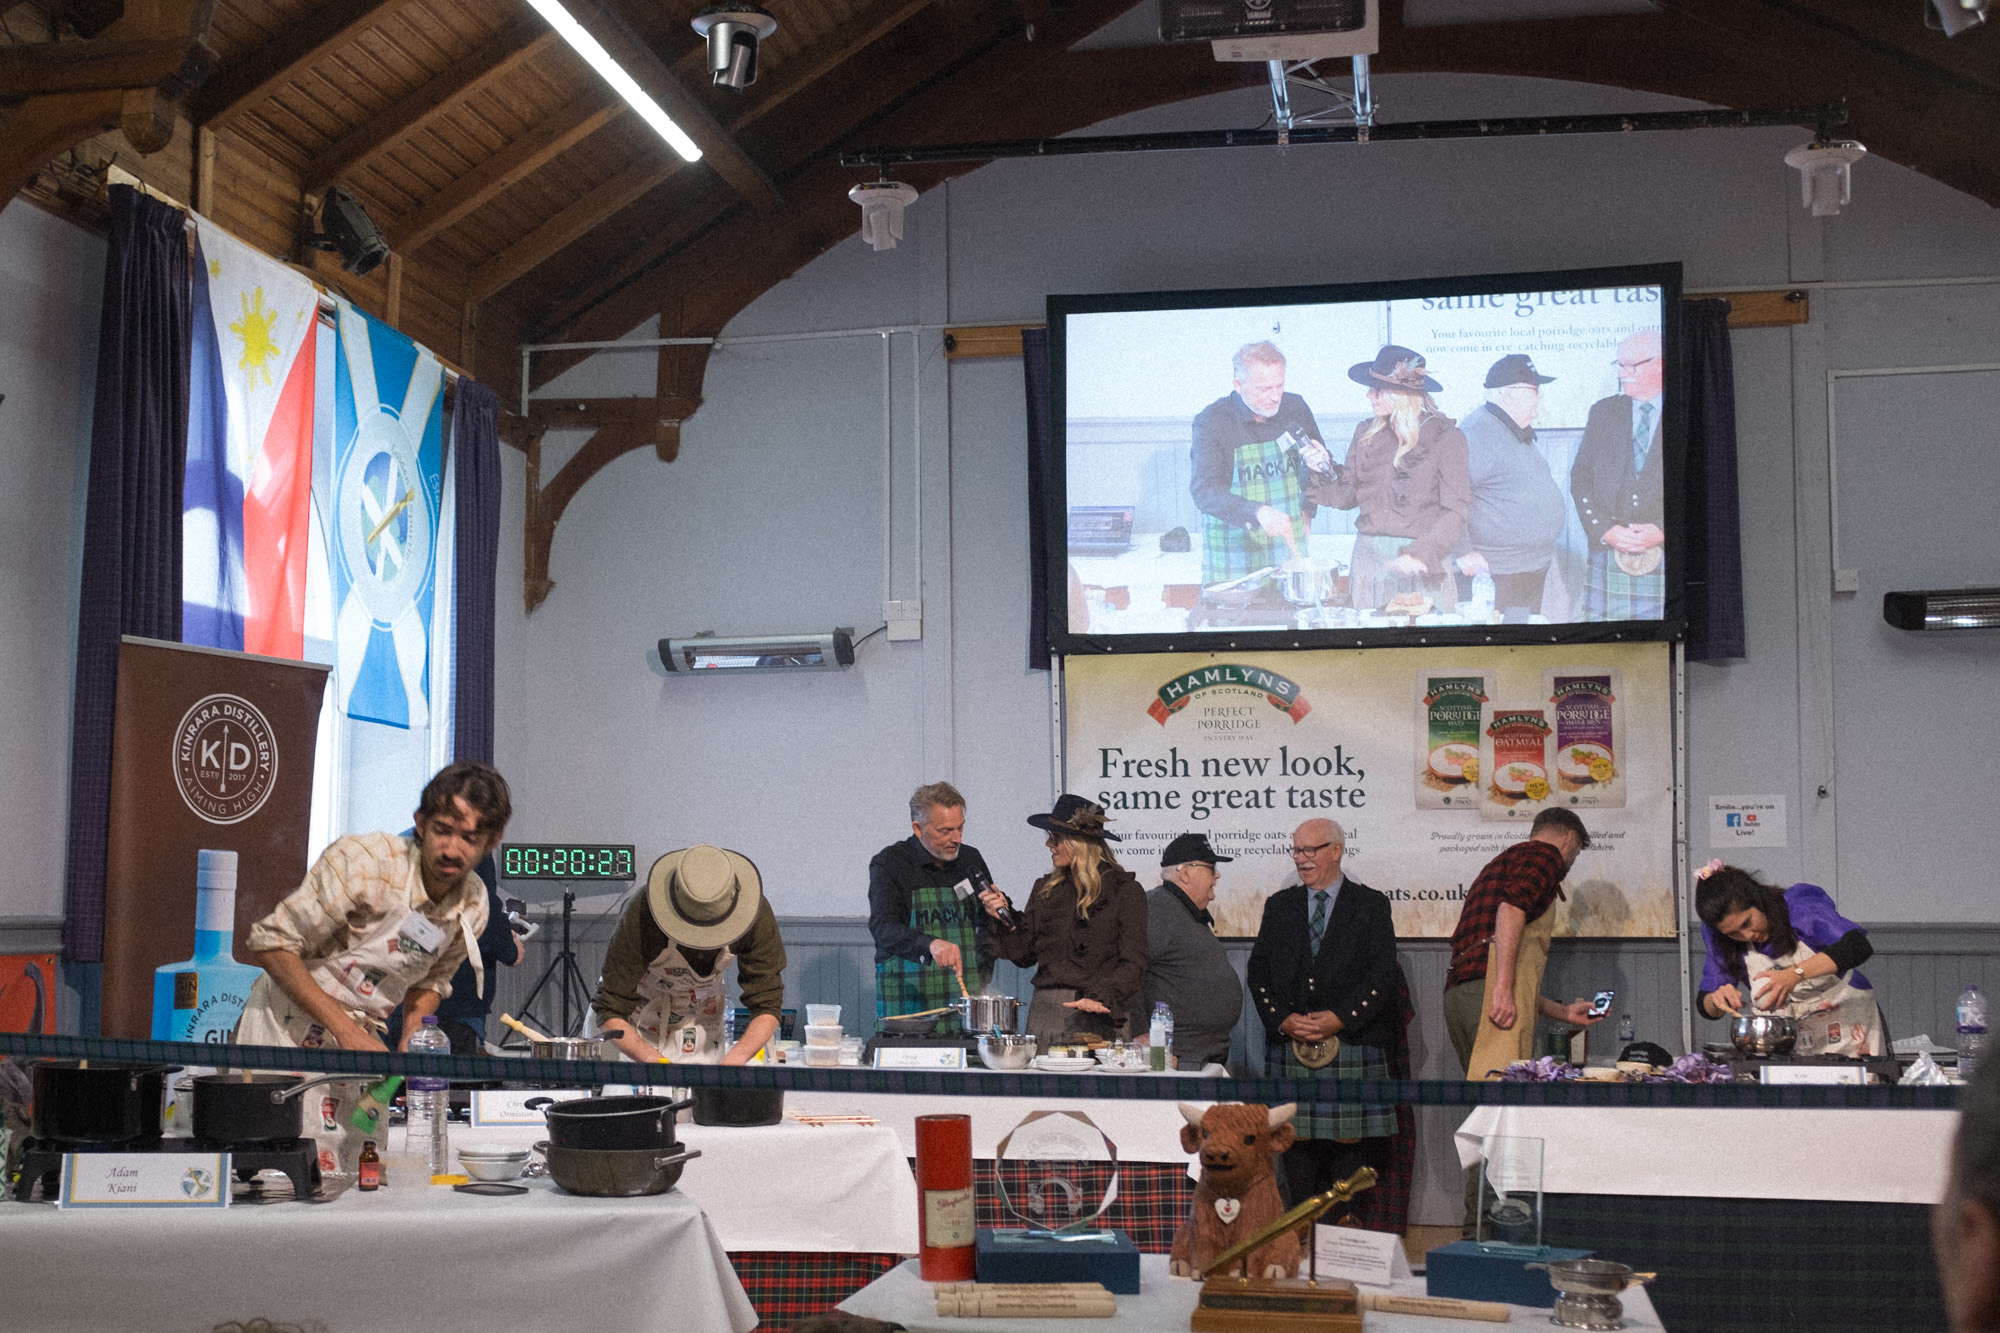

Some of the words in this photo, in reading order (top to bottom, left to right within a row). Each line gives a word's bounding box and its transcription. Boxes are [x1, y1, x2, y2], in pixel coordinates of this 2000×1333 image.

[1431, 327, 1456, 340] Your
[1459, 326, 1507, 338] favourite
[1510, 325, 1536, 337] local
[1538, 324, 1585, 340] porridge
[1588, 326, 1611, 335] oats
[1614, 323, 1636, 334] and
[1426, 345, 1447, 354] now
[1450, 344, 1479, 353] come
[1482, 342, 1493, 352] in
[1166, 668, 1291, 699] HAMLYNS
[1430, 683, 1482, 697] HAMLYNS
[1556, 683, 1609, 696] HAMLYNS
[1194, 692, 1207, 700] OF
[1211, 688, 1264, 699] SCOTLAND
[1203, 706, 1255, 717] PERFECT
[1197, 719, 1261, 731] PORRIDGE
[1493, 715, 1546, 728] HAMLYNS
[181, 705, 221, 761] KINRARA
[223, 704, 270, 773] DISTILLERY
[201, 739, 222, 769] K
[229, 742, 251, 771] D
[1098, 746, 1191, 779] Fresh
[1201, 757, 1271, 778] new
[1278, 745, 1365, 783] look,
[228, 773, 247, 781] 2017
[184, 777, 227, 814] AIMING
[232, 781, 264, 812] HIGH
[1098, 789, 1181, 810] same
[1191, 786, 1276, 820] great
[1286, 785, 1366, 809] taste
[1214, 829, 1261, 842] porridge
[1264, 830, 1287, 840] oats
[1430, 831, 1465, 842] Proudly
[1466, 834, 1493, 842] grown
[1494, 832, 1503, 840] in
[1608, 830, 1626, 839] and
[1127, 847, 1155, 856] come
[506, 848, 631, 875] 00:20:27
[106, 1166, 139, 1180] Adam
[107, 1181, 138, 1194] Kiani
